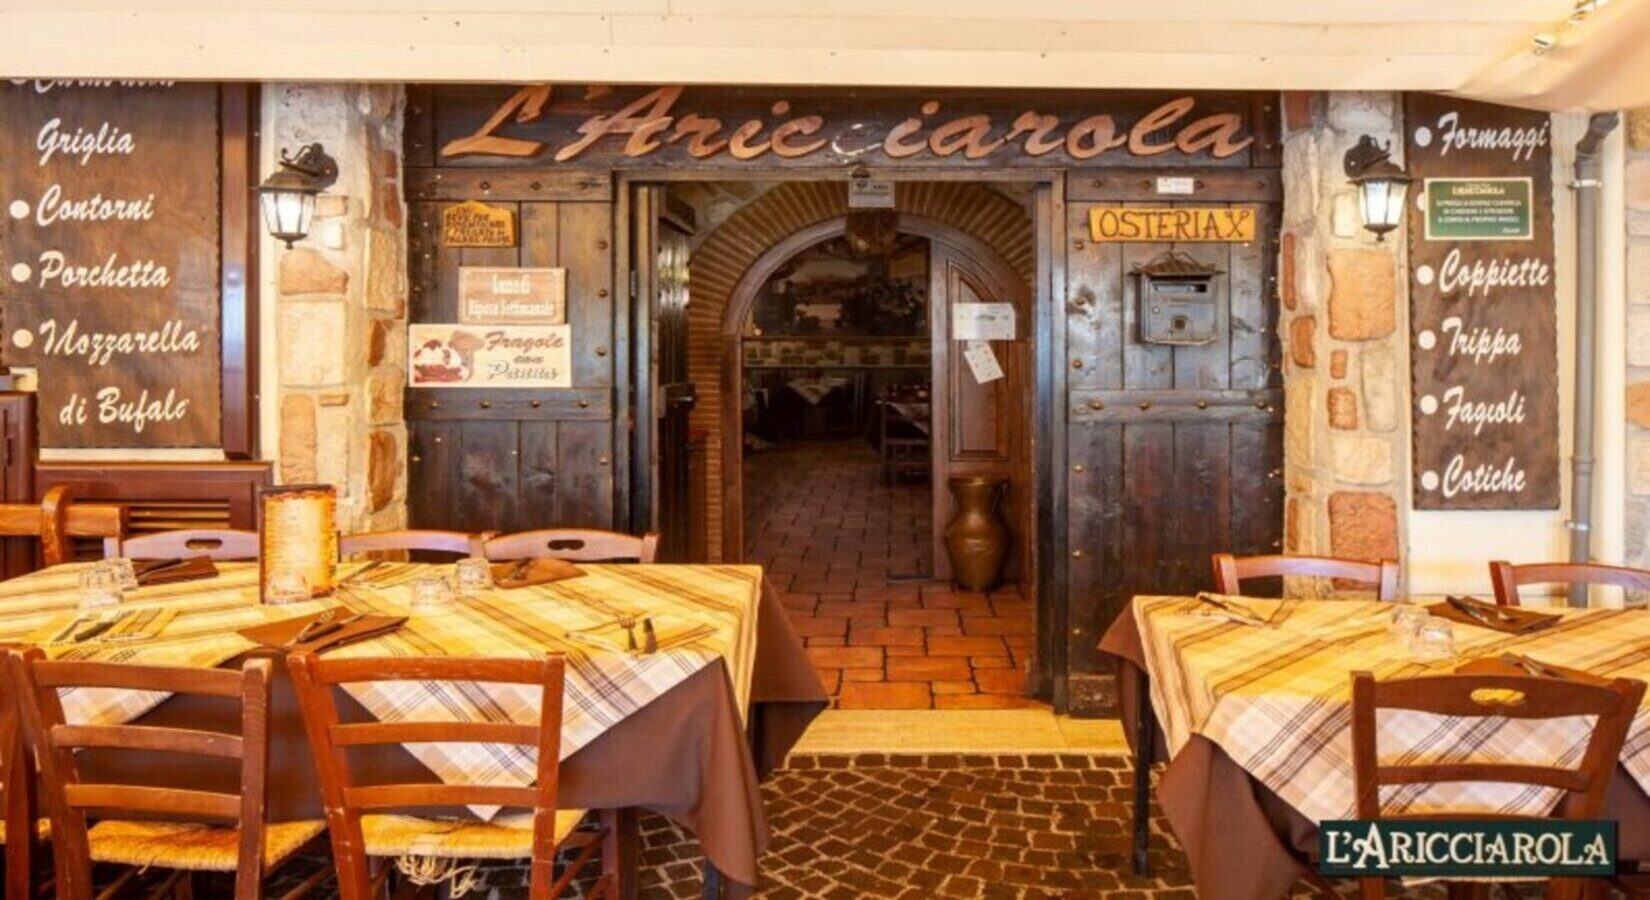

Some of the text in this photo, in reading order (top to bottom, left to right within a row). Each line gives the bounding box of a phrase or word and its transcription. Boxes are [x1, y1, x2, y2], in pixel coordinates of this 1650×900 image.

[36, 117, 136, 166] Griglia
[1437, 112, 1549, 161] Formaggi
[36, 184, 155, 226] Contorni
[38, 250, 170, 288] Porchetta
[1438, 248, 1550, 297] Coppiette
[39, 318, 200, 365] Mozzarella
[485, 331, 564, 353] Fragole
[1442, 316, 1522, 365] Trippa
[59, 393, 88, 425] di
[1443, 385, 1526, 436] Fagioli
[1443, 454, 1526, 498] Cotiche
